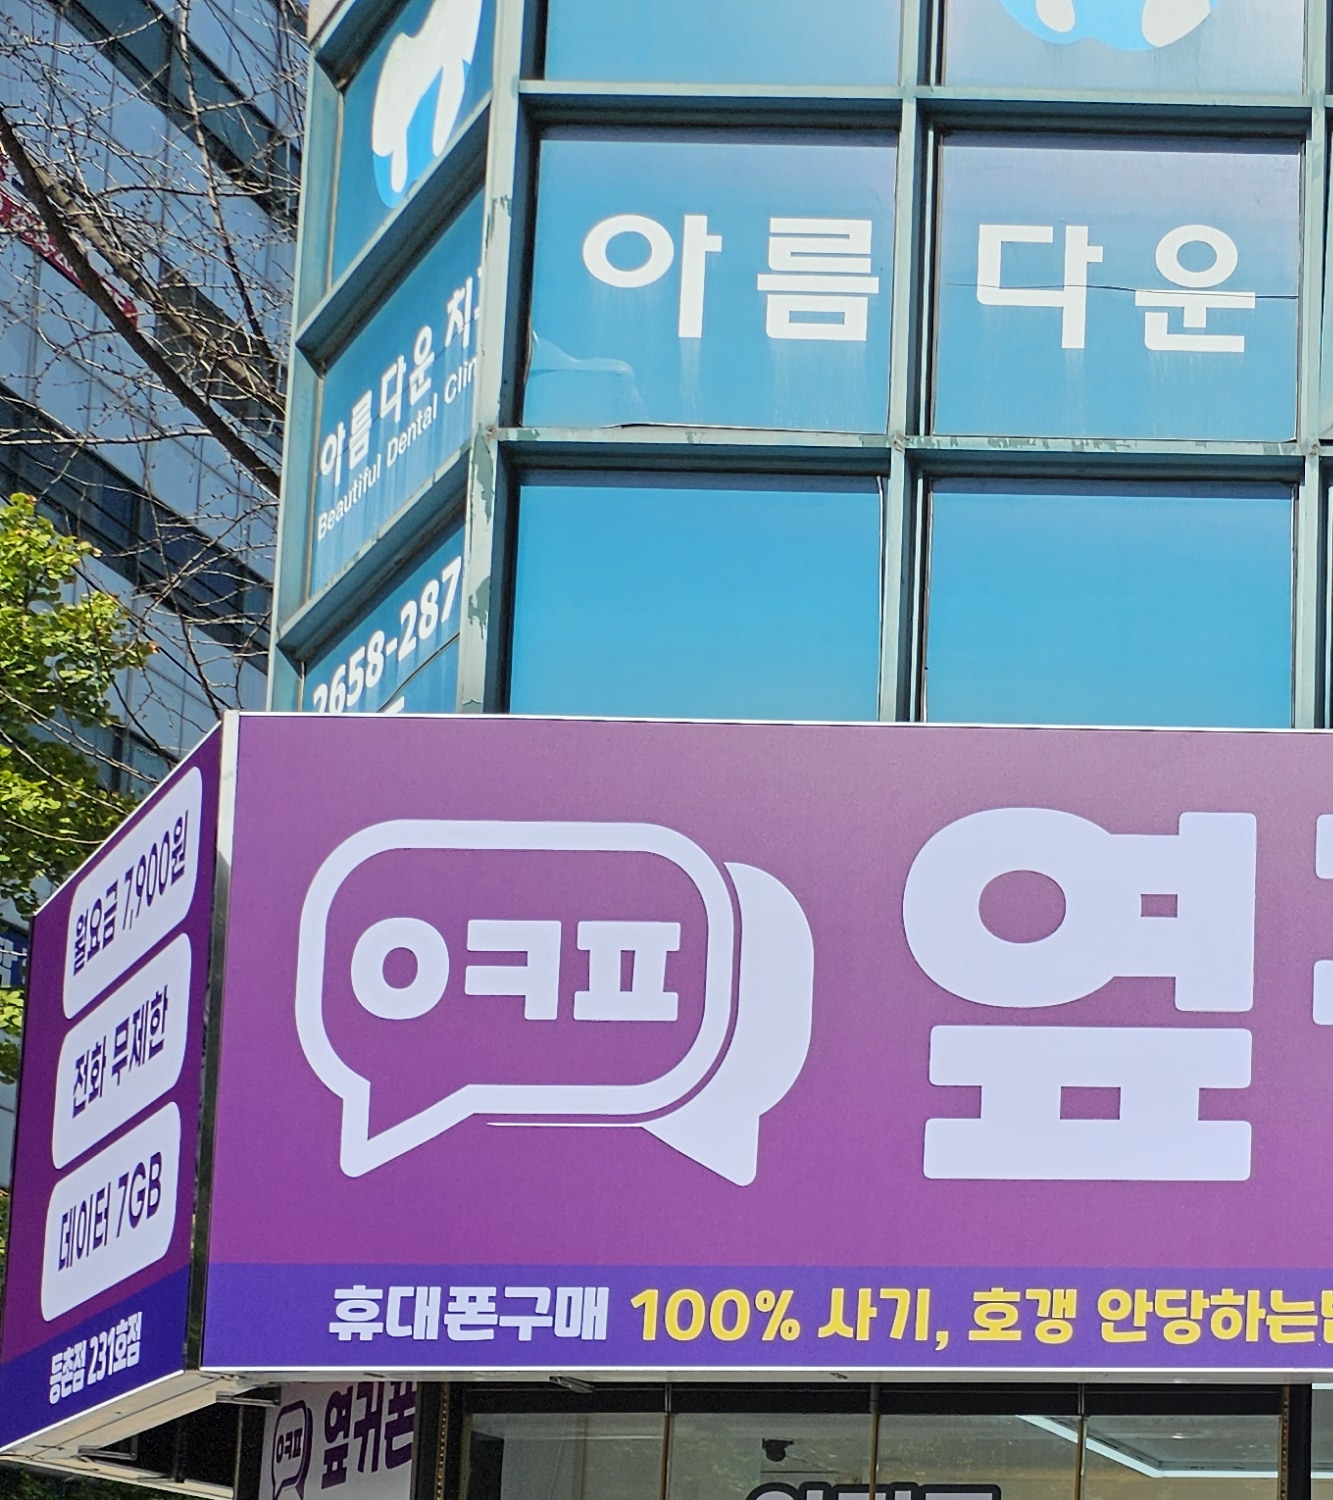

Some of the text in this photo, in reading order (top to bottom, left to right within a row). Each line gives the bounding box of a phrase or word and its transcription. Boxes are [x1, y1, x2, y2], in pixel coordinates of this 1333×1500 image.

[317, 453, 382, 541] Beautiful
[386, 393, 438, 468] Dental
[320, 326, 435, 487] 아름다운
[73, 879, 119, 977] 월요금
[122, 810, 189, 930] 7,900원
[72, 984, 169, 1119] 전화 무제한
[58, 1151, 162, 1272] 데이터 7GB
[50, 1311, 142, 1405] 등촌점 231호점
[329, 1285, 609, 1342] 휴대폰구매
[630, 1288, 801, 1342] 100%
[819, 1287, 949, 1351] 사기,
[968, 1287, 1076, 1346] 호갱
